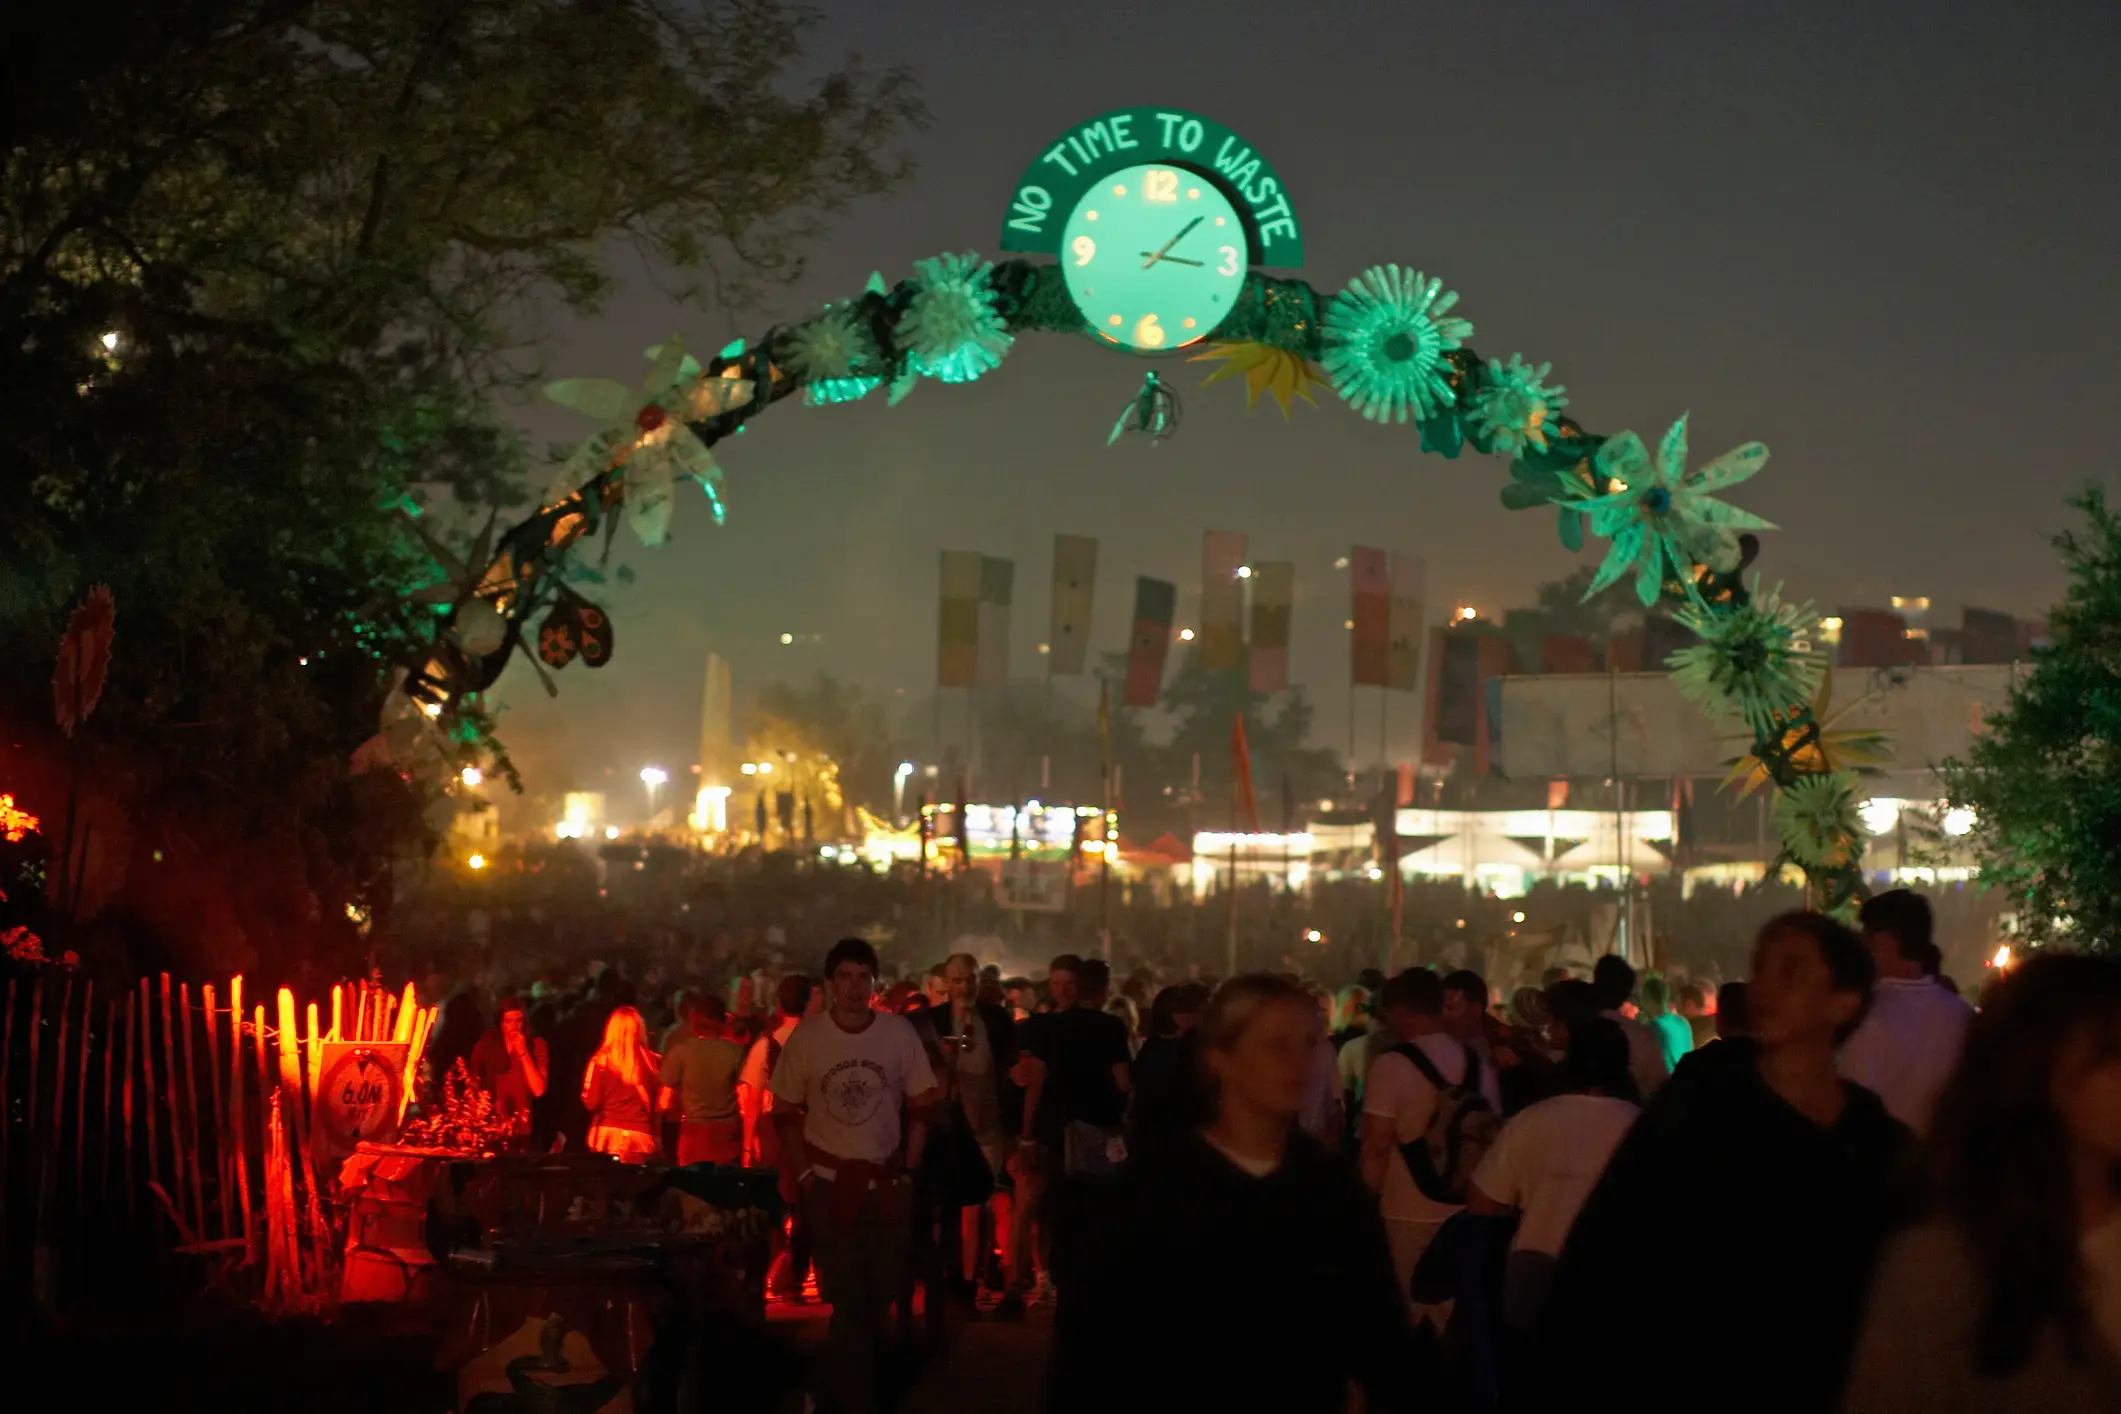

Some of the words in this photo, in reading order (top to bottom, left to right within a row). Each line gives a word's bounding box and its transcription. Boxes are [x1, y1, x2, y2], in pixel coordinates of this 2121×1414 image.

[1008, 185, 1053, 233] NO
[1043, 114, 1139, 176] TIME
[1156, 112, 1204, 152] TO
[1214, 135, 1297, 247] WASTE
[1145, 170, 1178, 201] 12
[1072, 235, 1096, 267] 9
[1217, 245, 1239, 277] 3
[1138, 313, 1165, 347] 6
